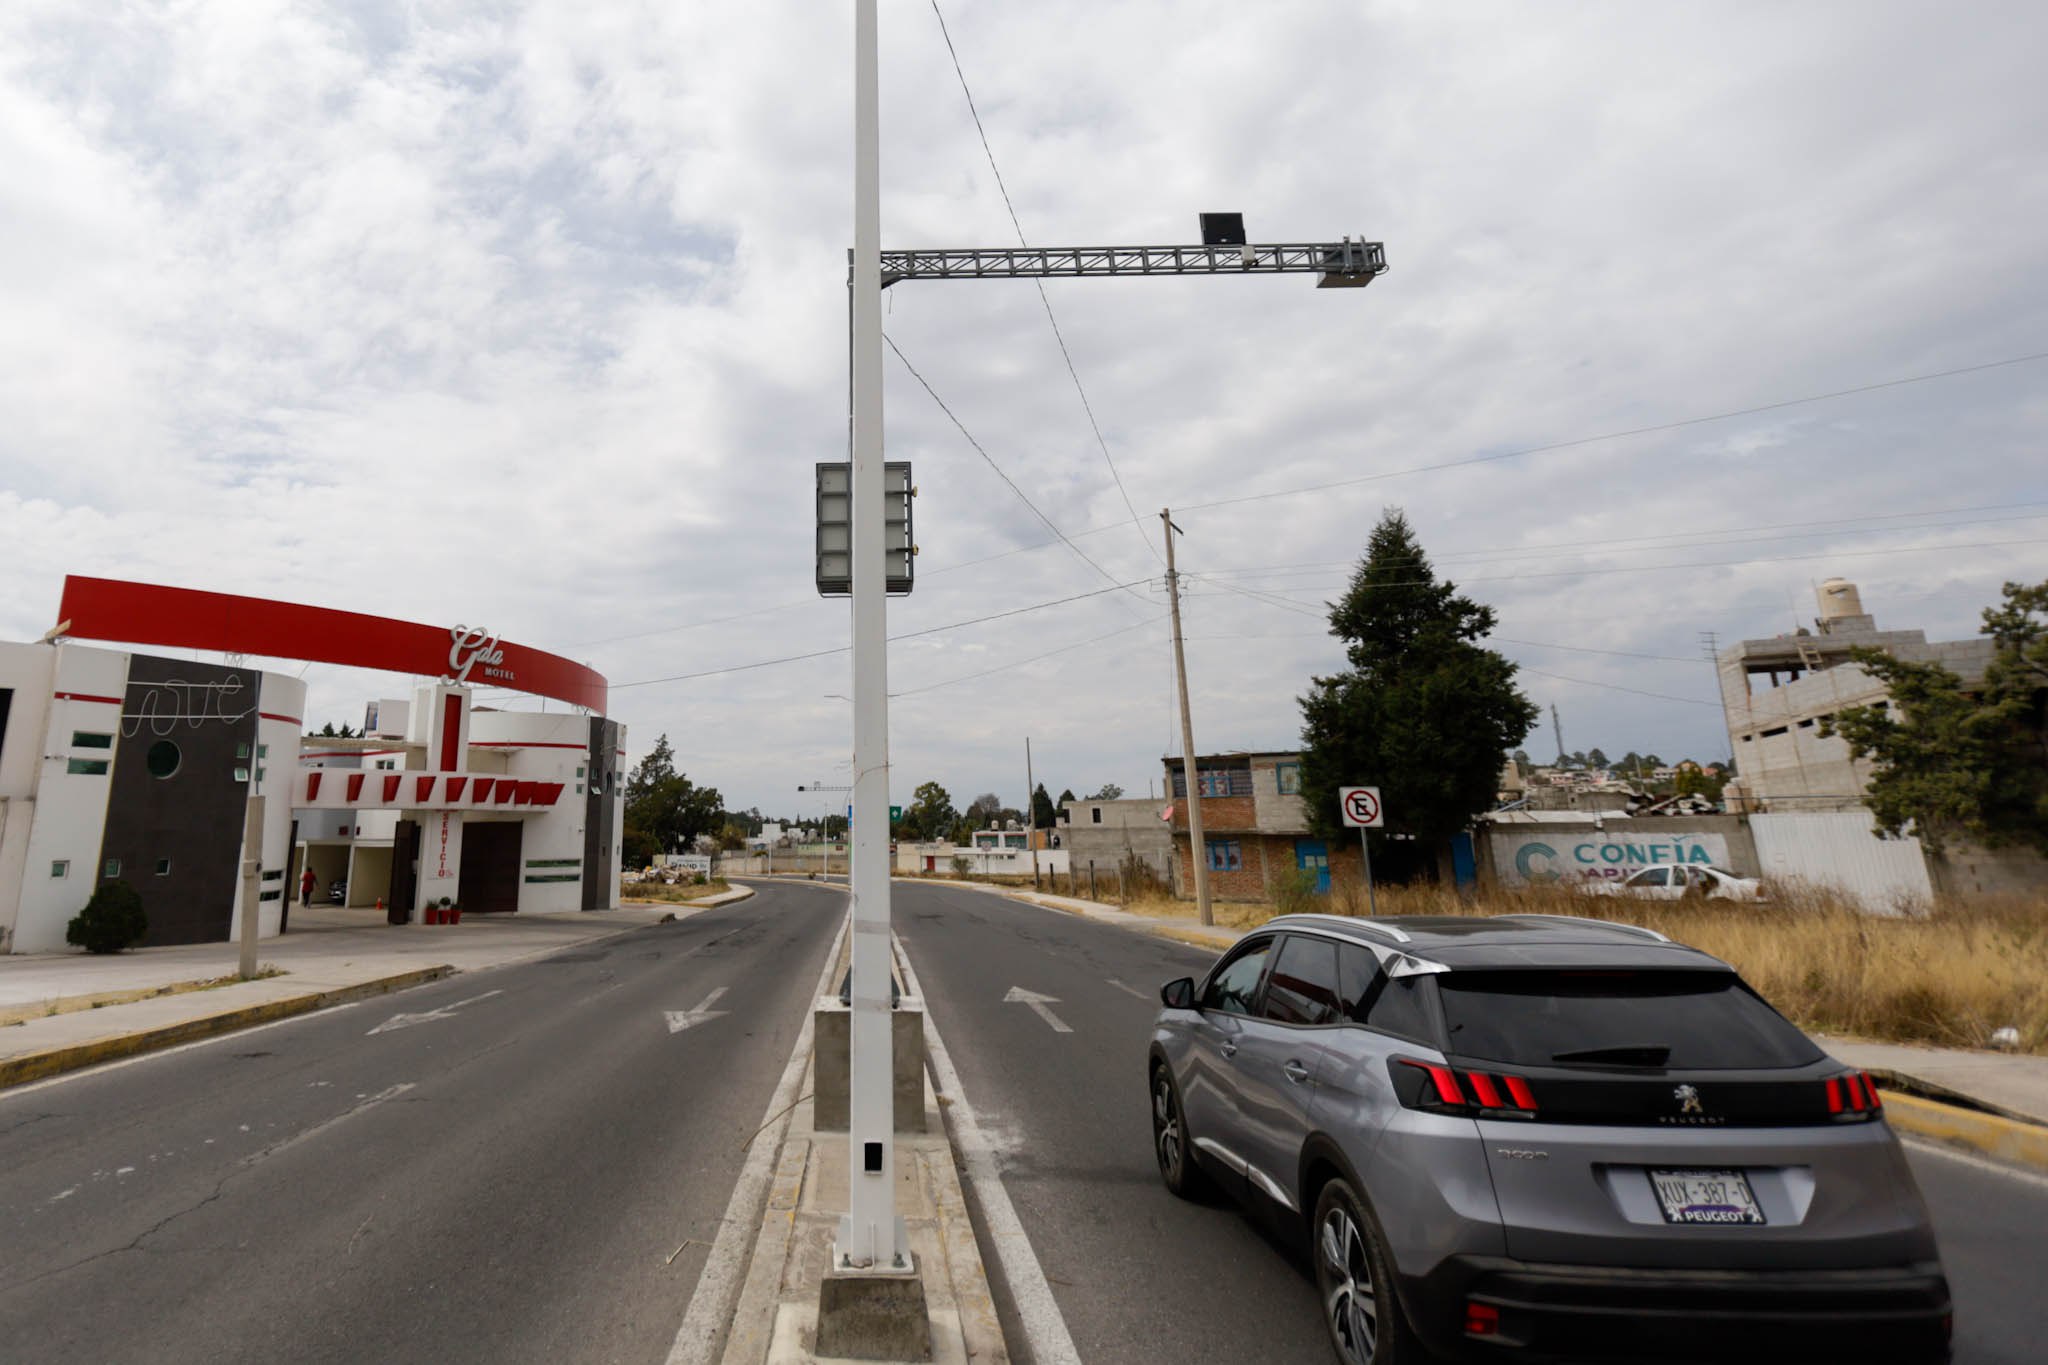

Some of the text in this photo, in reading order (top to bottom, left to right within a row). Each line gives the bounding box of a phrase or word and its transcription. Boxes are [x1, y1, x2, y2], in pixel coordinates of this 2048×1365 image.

[440, 624, 504, 687] Gala
[484, 667, 516, 680] MOTEL
[438, 812, 448, 877] SERVICIO
[1685, 1211, 1745, 1221] PEUGEOT
